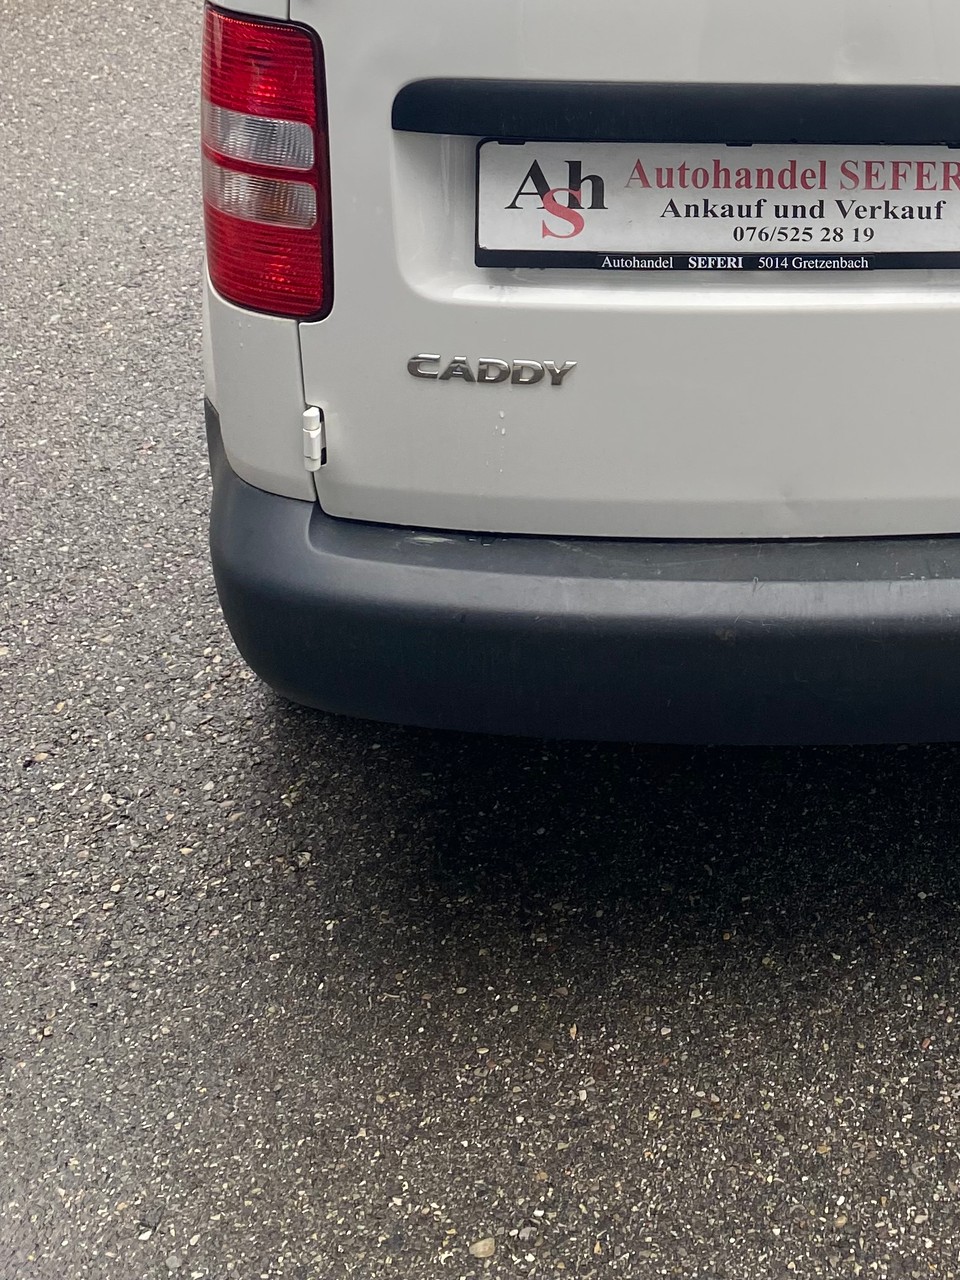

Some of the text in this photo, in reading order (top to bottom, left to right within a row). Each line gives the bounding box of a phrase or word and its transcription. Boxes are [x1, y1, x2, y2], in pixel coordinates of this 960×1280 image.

[624, 157, 828, 190] Autohandel
[659, 198, 947, 221] Ankauf und Verkauf
[733, 226, 876, 243] 076/525 28 19
[601, 255, 869, 270] Autohandel SEFERI 5014 Gretzenbach
[407, 353, 578, 386] CADDY
